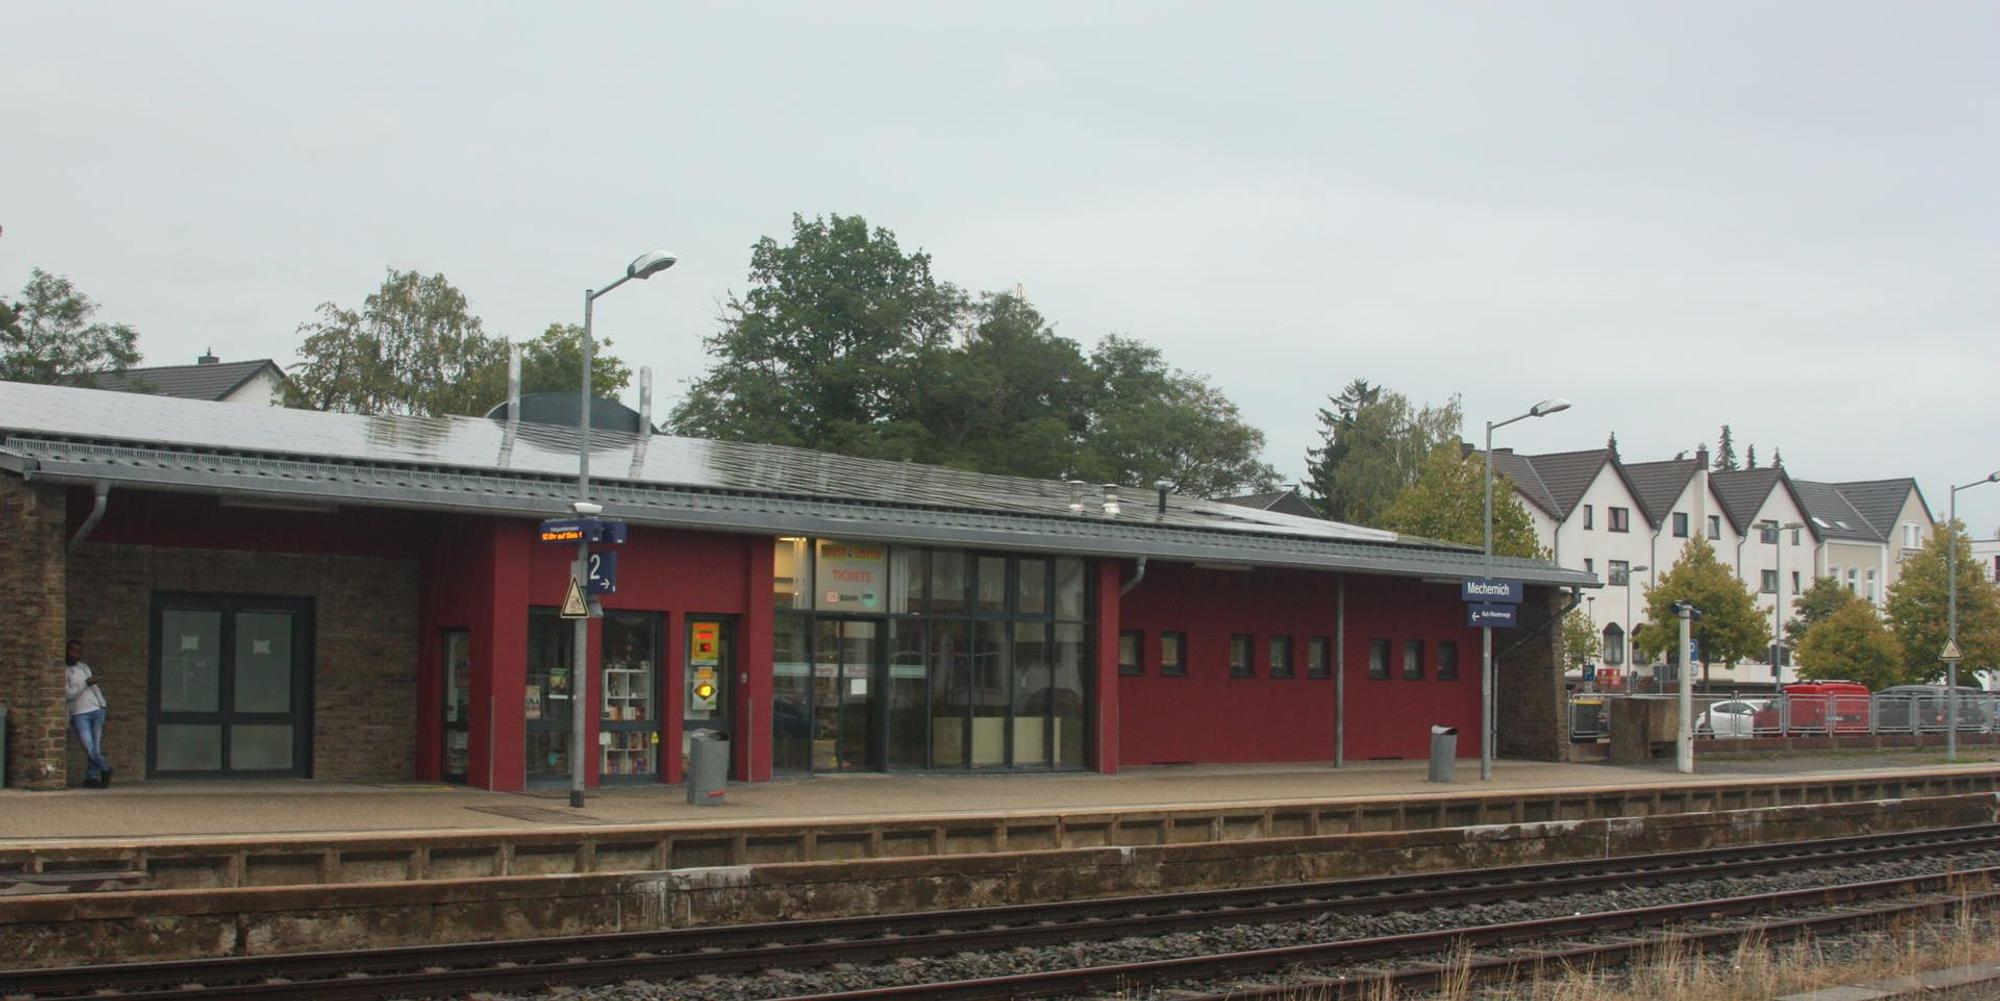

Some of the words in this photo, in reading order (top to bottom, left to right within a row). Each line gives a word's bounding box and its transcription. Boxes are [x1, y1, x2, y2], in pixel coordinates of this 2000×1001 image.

[590, 554, 601, 580] 2
[832, 570, 874, 583] TICKETS
[1467, 582, 1510, 596] Mechernich
